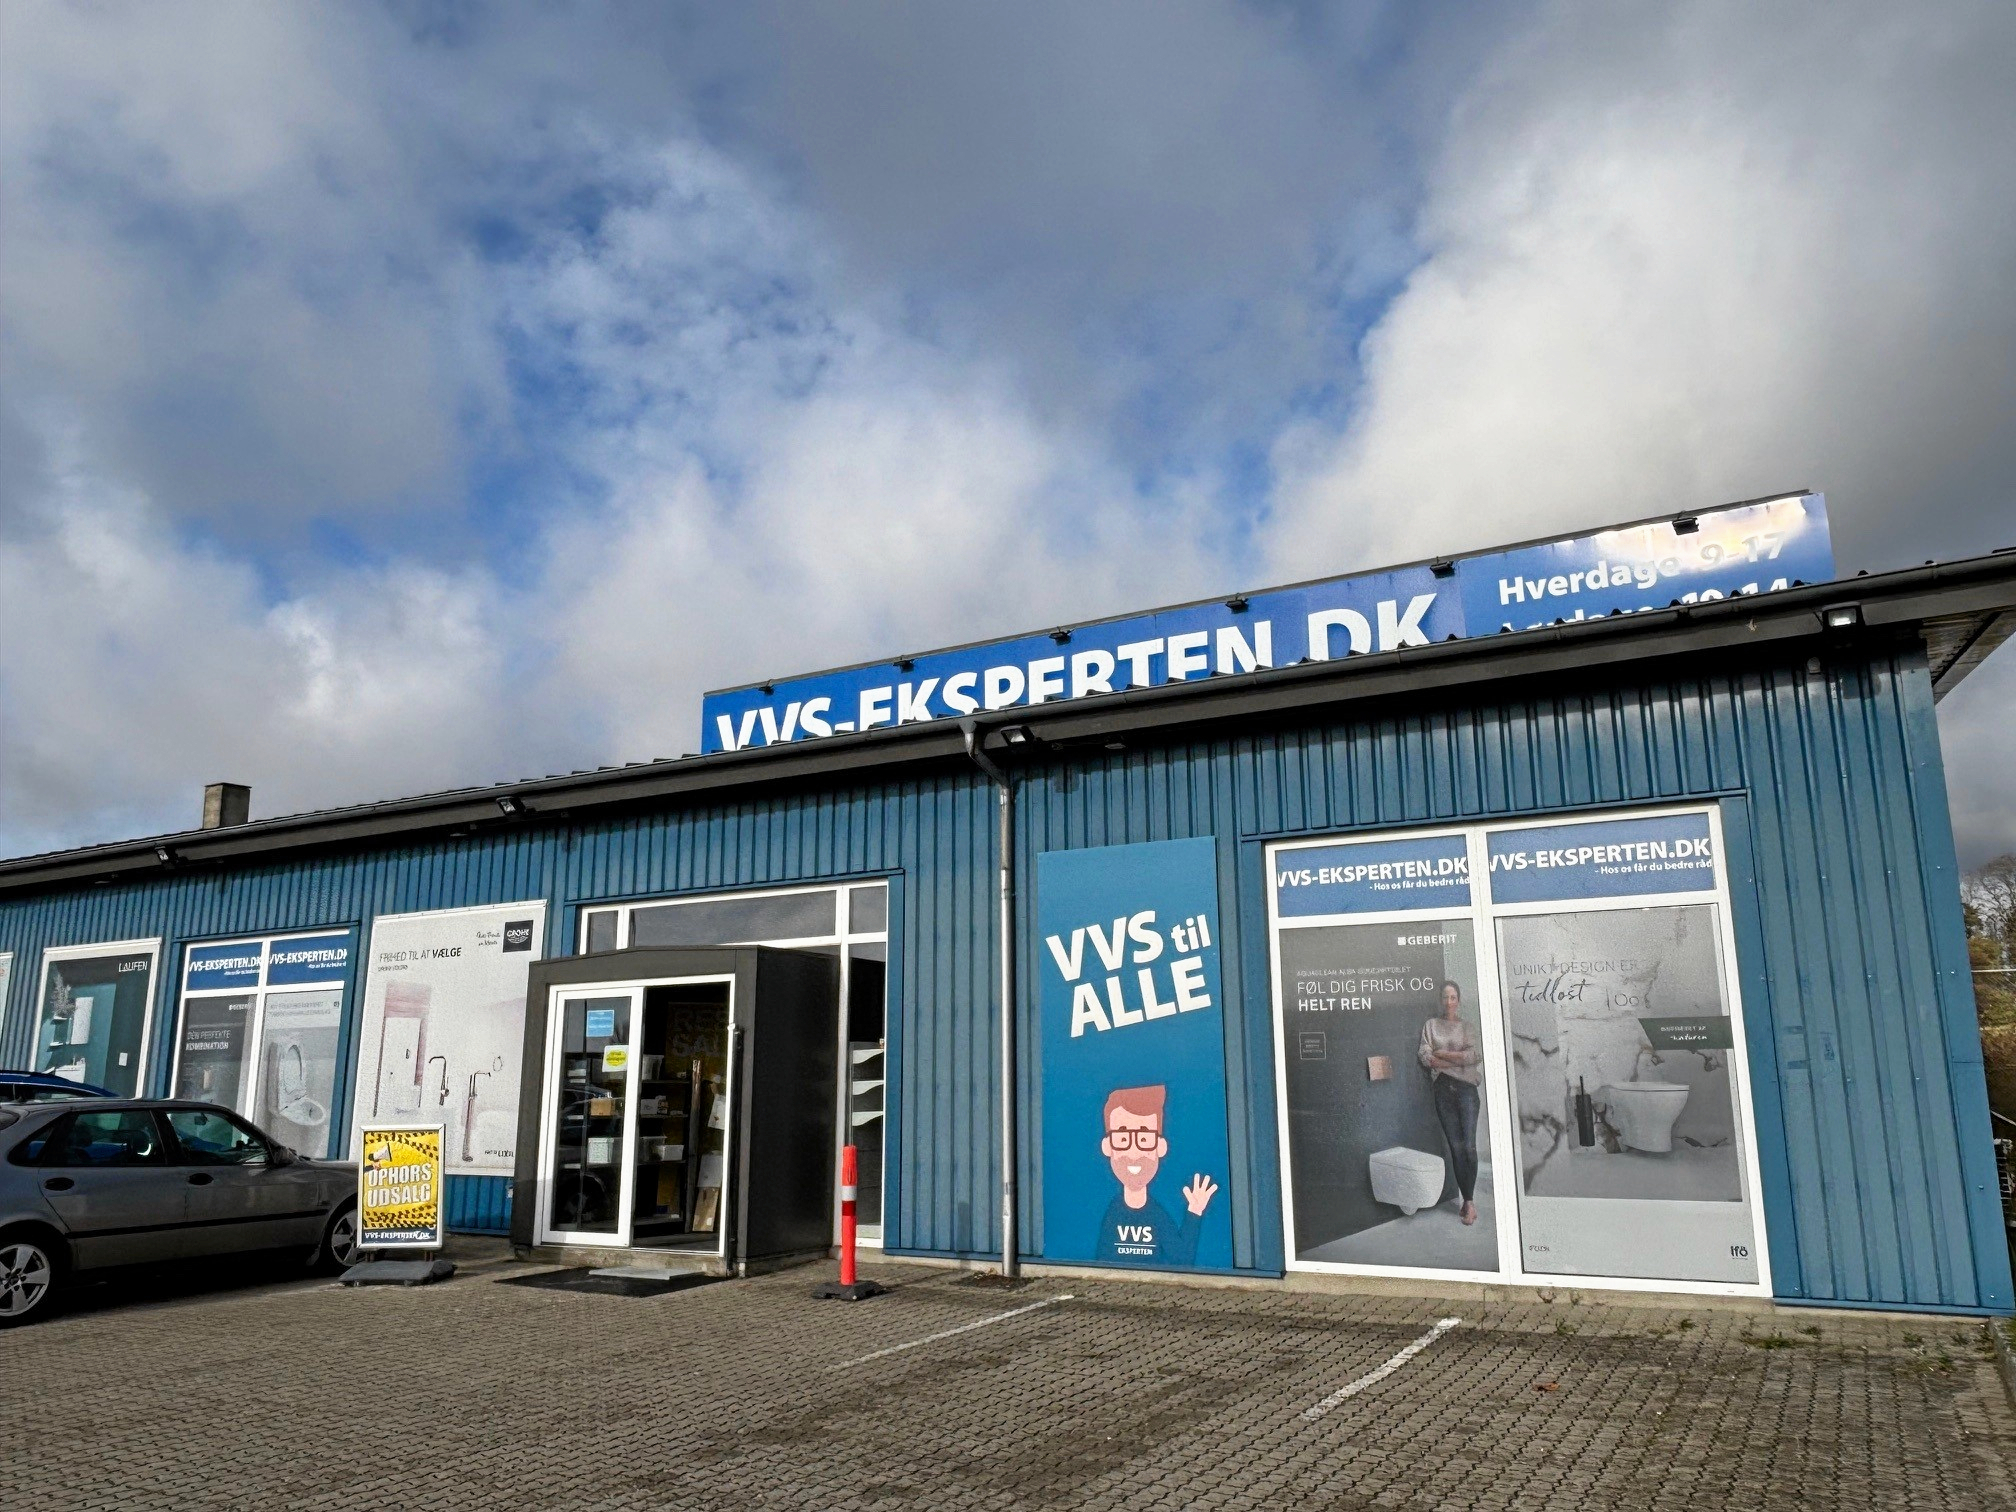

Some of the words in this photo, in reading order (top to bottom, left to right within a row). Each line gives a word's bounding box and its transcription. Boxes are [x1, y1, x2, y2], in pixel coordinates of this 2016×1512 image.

[1499, 556, 1680, 605] Hverdage
[1700, 531, 1785, 571] 9-17
[1489, 838, 1711, 872] VVS-EKSPERTEN.DK
[1278, 857, 1468, 888] VVS-EKSPERTEN.DK
[1601, 865, 1619, 875] Hos
[1633, 863, 1648, 872] får
[1649, 862, 1663, 871] du
[1665, 860, 1694, 870] bedre
[1374, 882, 1390, 891] Hos
[1402, 880, 1415, 889] får
[1416, 879, 1428, 888] du
[1429, 878, 1454, 887] bedre
[1046, 910, 1164, 982] VVS
[1171, 914, 1212, 953] til
[1407, 934, 1458, 945] GEBERIT
[420, 949, 431, 960] AT
[432, 947, 462, 959] VÆLGE
[118, 961, 148, 972] LAUFEN
[1560, 960, 1616, 975] DESIGN
[1297, 981, 1326, 994] FØL
[1330, 980, 1356, 994] DIG
[1361, 978, 1405, 993] FRISK
[1410, 977, 1434, 991] OG
[1071, 955, 1212, 1038] ALLE
[1298, 998, 1336, 1012] HELT
[1341, 998, 1372, 1010] REN
[367, 1183, 431, 1208] UDSALG
[1117, 1225, 1153, 1243] VVS
